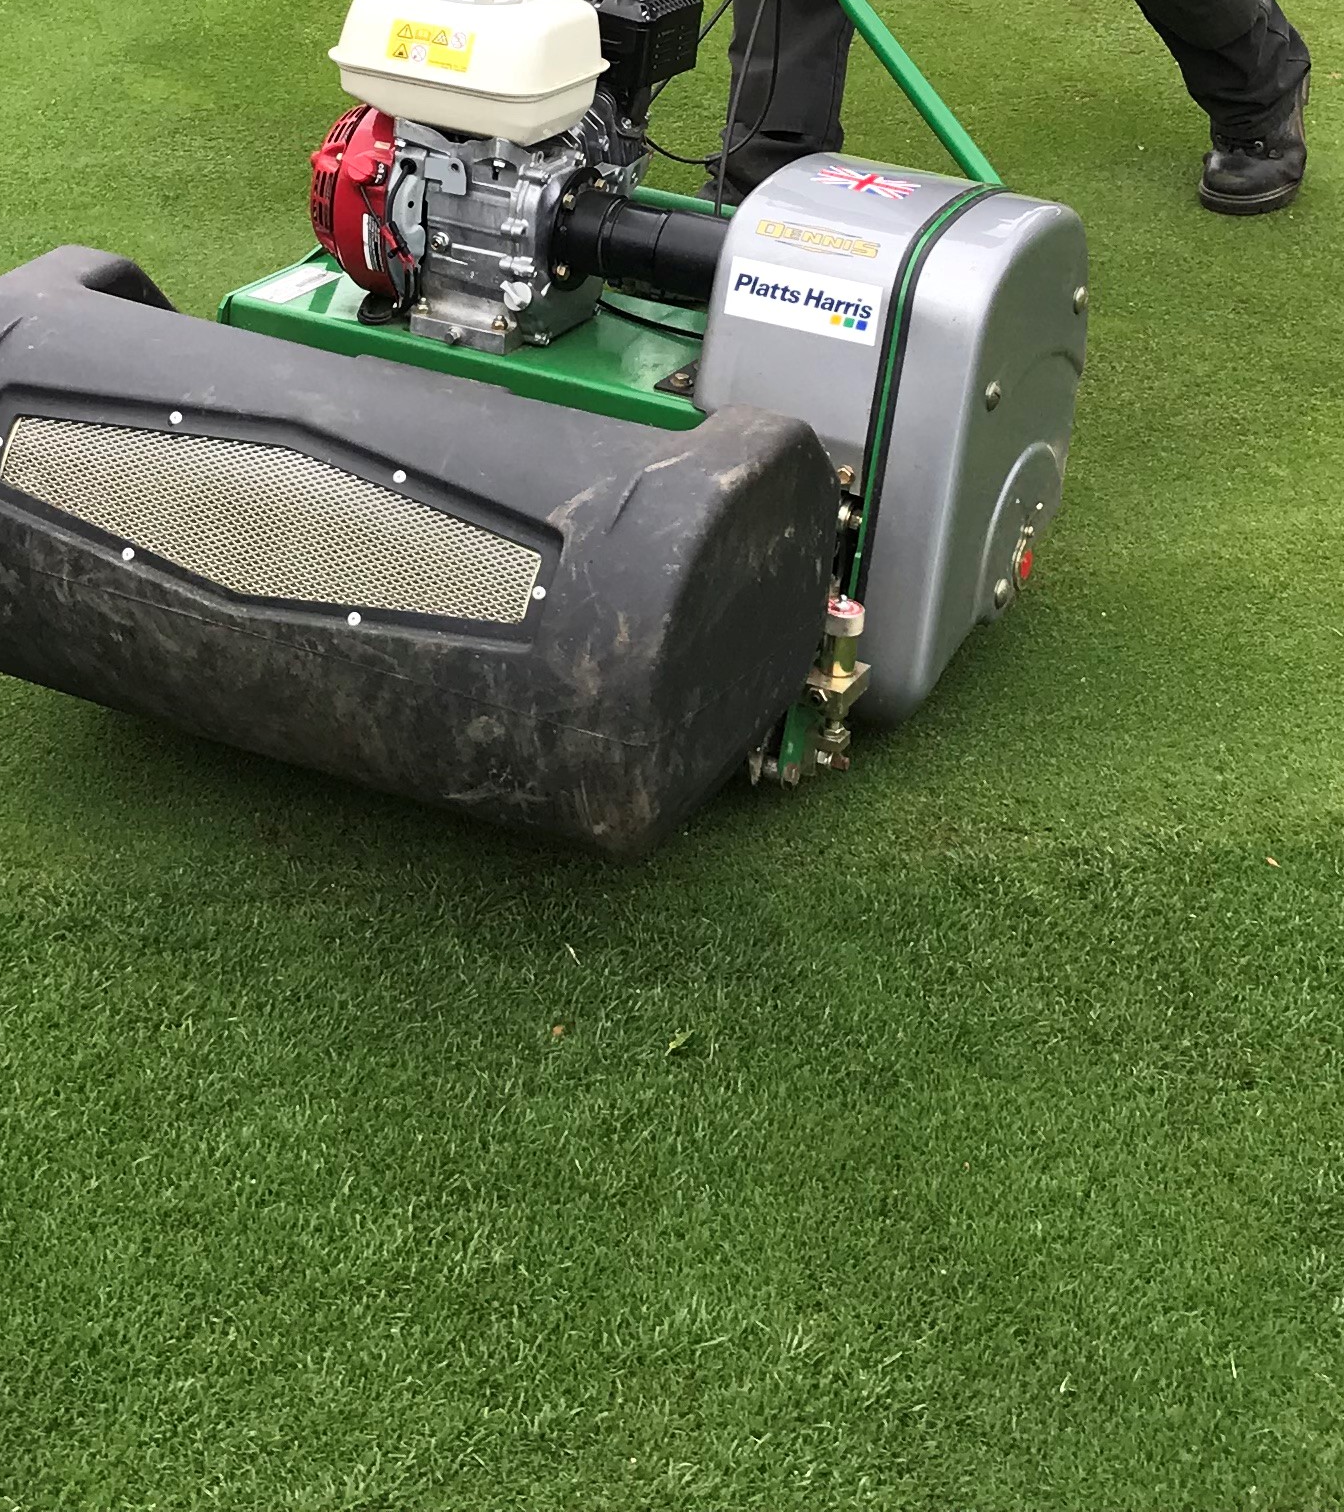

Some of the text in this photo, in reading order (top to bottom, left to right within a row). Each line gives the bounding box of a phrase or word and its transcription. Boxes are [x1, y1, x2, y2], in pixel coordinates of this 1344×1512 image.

[755, 219, 881, 258] DENNIS
[734, 273, 873, 319] Platts Harris
